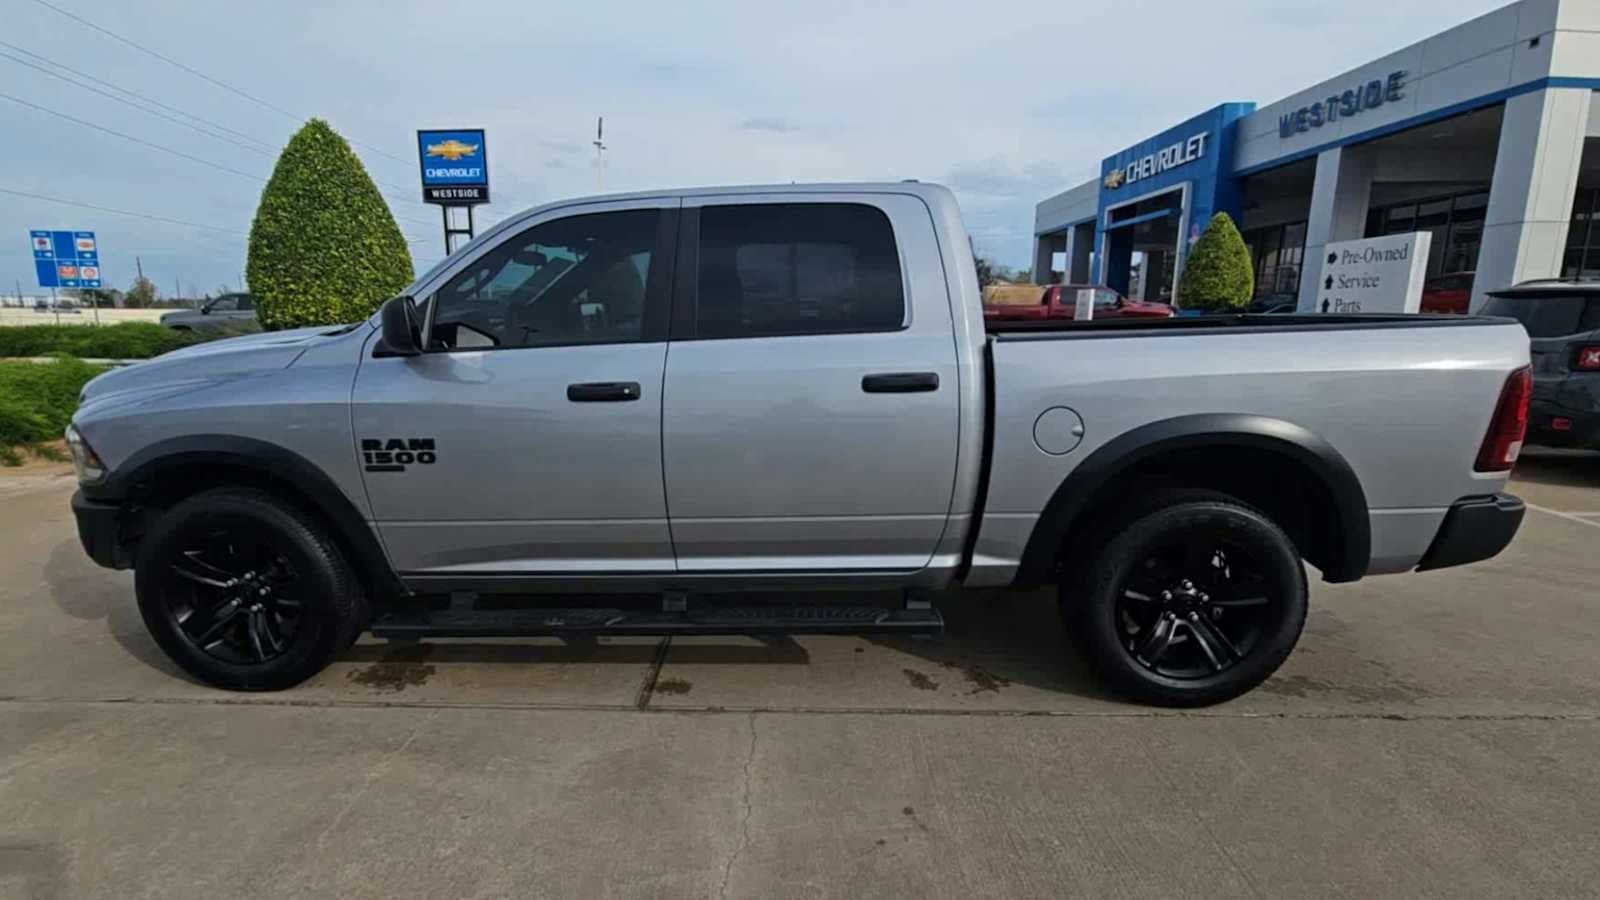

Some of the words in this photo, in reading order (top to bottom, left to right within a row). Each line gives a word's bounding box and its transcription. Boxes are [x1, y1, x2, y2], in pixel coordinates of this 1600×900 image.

[1279, 69, 1407, 138] WESTSIDE
[1126, 131, 1209, 184] CHEVROLET
[425, 167, 481, 177] CHEVROLET
[431, 189, 479, 198] WESTSIDE
[1341, 243, 1409, 265] Pre-Owned
[1337, 273, 1380, 289] Service
[1334, 298, 1362, 313] Parts
[361, 438, 435, 451] RAM
[363, 452, 436, 464] 1500
